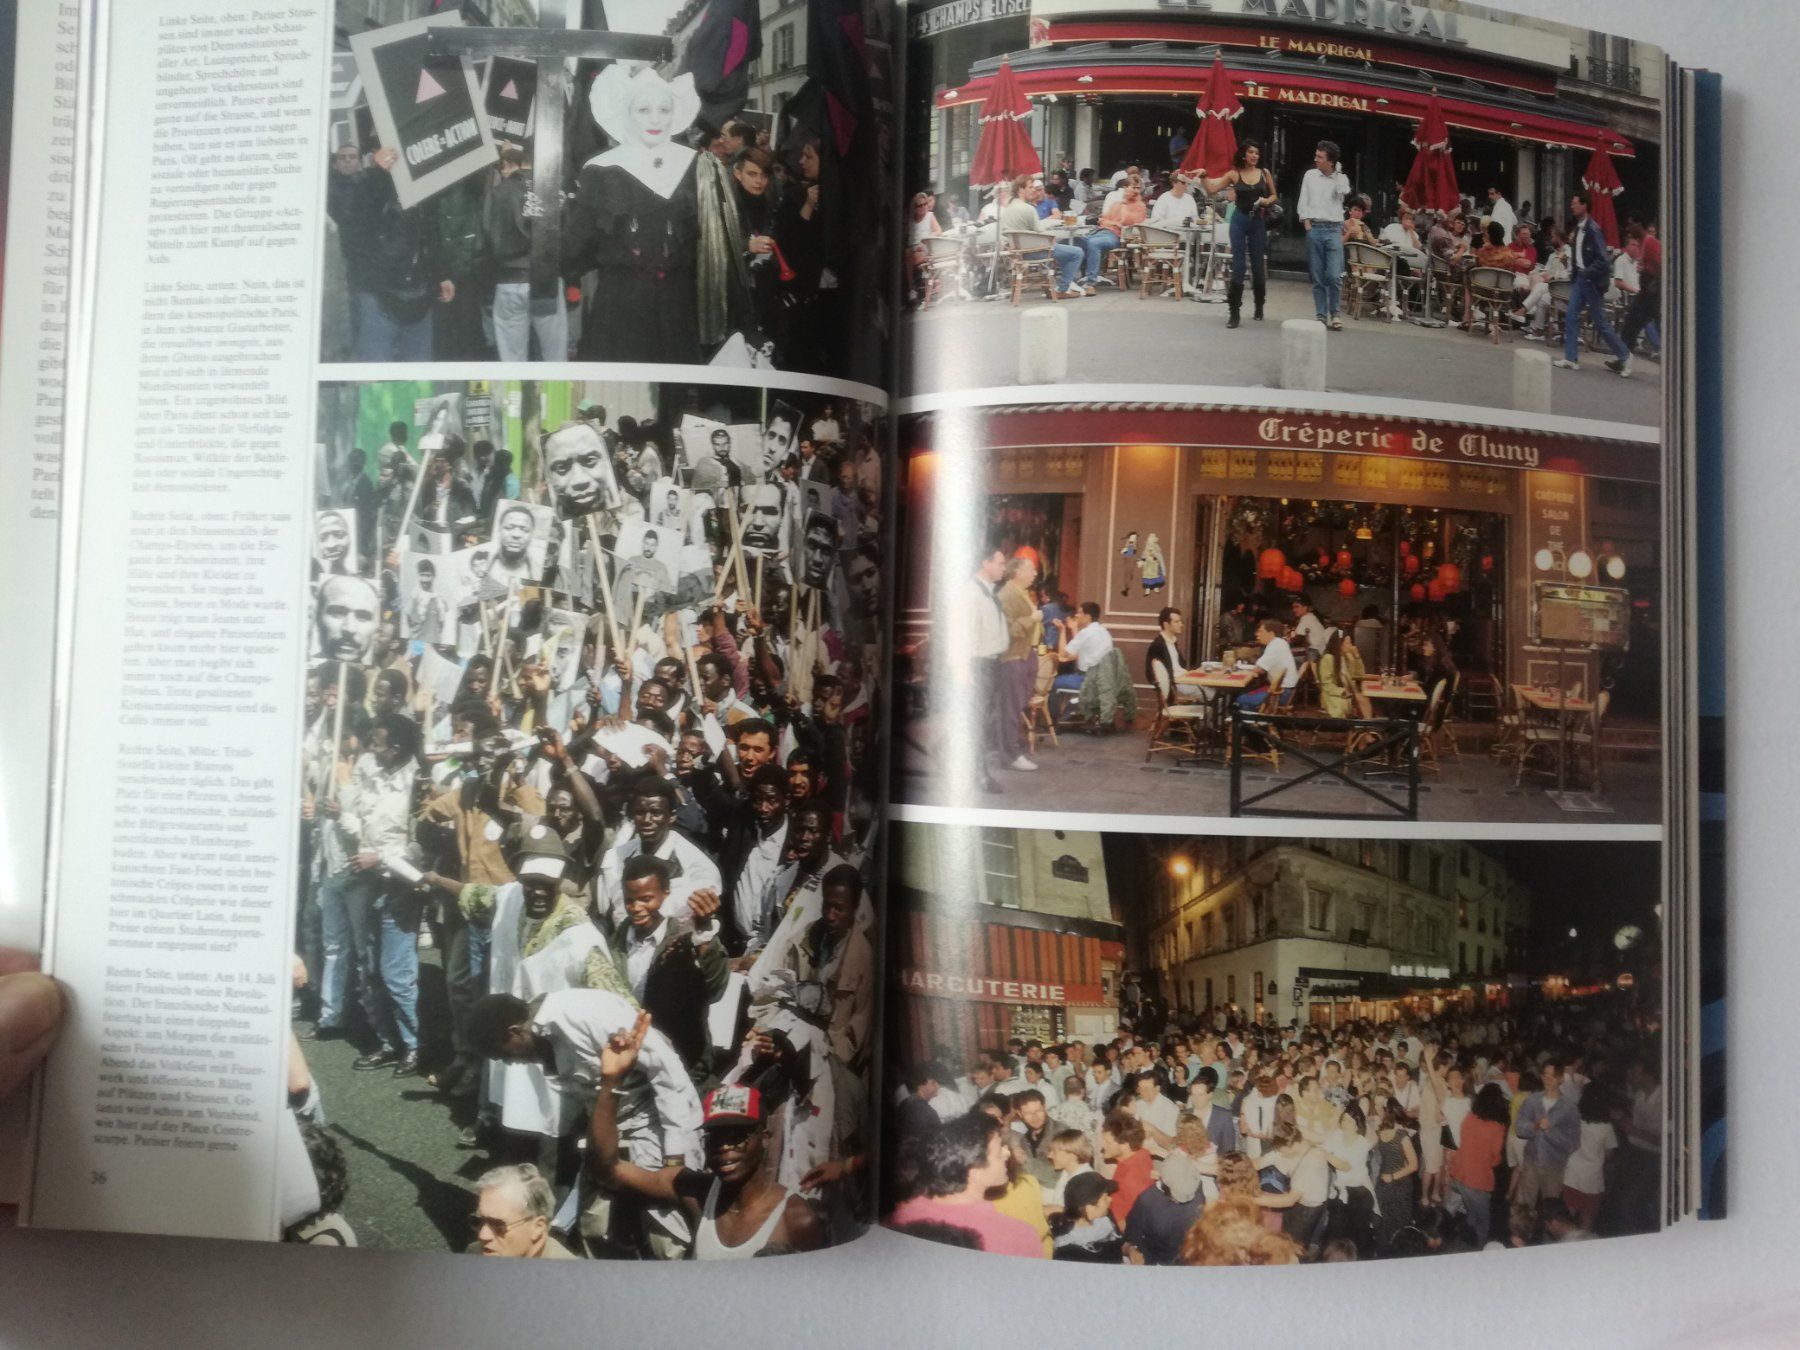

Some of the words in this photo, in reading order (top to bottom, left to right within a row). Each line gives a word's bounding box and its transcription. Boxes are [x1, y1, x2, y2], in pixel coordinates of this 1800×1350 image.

[931, 0, 980, 29] CHAMPS
[1260, 35, 1280, 49] LE
[1288, 38, 1374, 61] MADRIGAL
[1248, 85, 1270, 99] LE
[1279, 87, 1372, 112] MADRIGAL
[1411, 429, 1445, 454] de
[1458, 433, 1540, 467] Cluny
